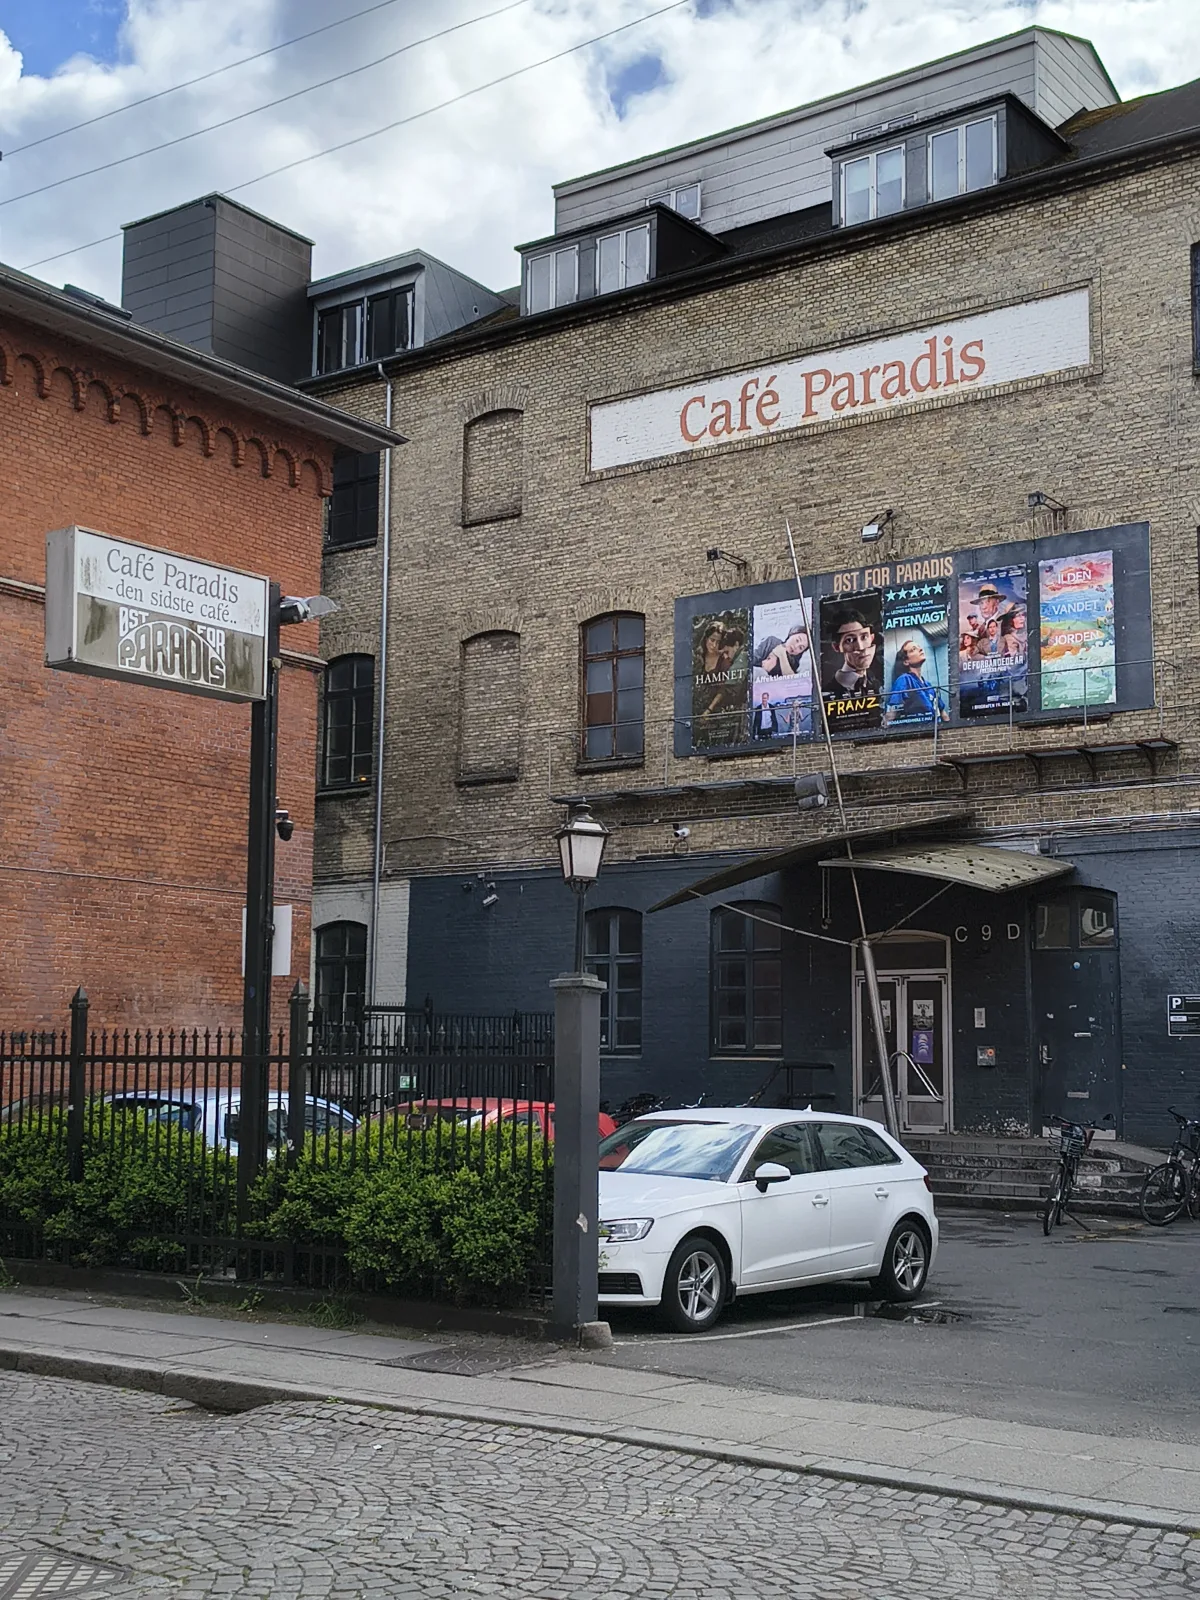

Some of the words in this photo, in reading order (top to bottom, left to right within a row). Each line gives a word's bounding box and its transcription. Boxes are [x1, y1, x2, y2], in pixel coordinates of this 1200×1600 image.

[679, 374, 781, 443] Café
[801, 335, 987, 418] Paradis
[107, 548, 154, 581] Café
[164, 562, 239, 603] Paradis
[833, 571, 860, 593] ØST
[865, 567, 890, 589] FOR
[897, 557, 954, 583] PARADIS
[1058, 569, 1092, 584] ILDEN
[150, 589, 194, 614] sidste
[1052, 600, 1098, 615] VANDET
[886, 610, 946, 630] AFTENVAGT
[118, 606, 150, 637] ØST
[197, 625, 226, 661] FOR
[1054, 630, 1099, 645] JORDEN
[118, 620, 226, 688] PARADIS
[695, 668, 746, 685] HAMNET
[827, 697, 880, 716] FRANZ
[954, 926, 969, 943] C
[981, 925, 992, 941] 9
[1007, 923, 1020, 940] D
[1172, 997, 1182, 1009] P
